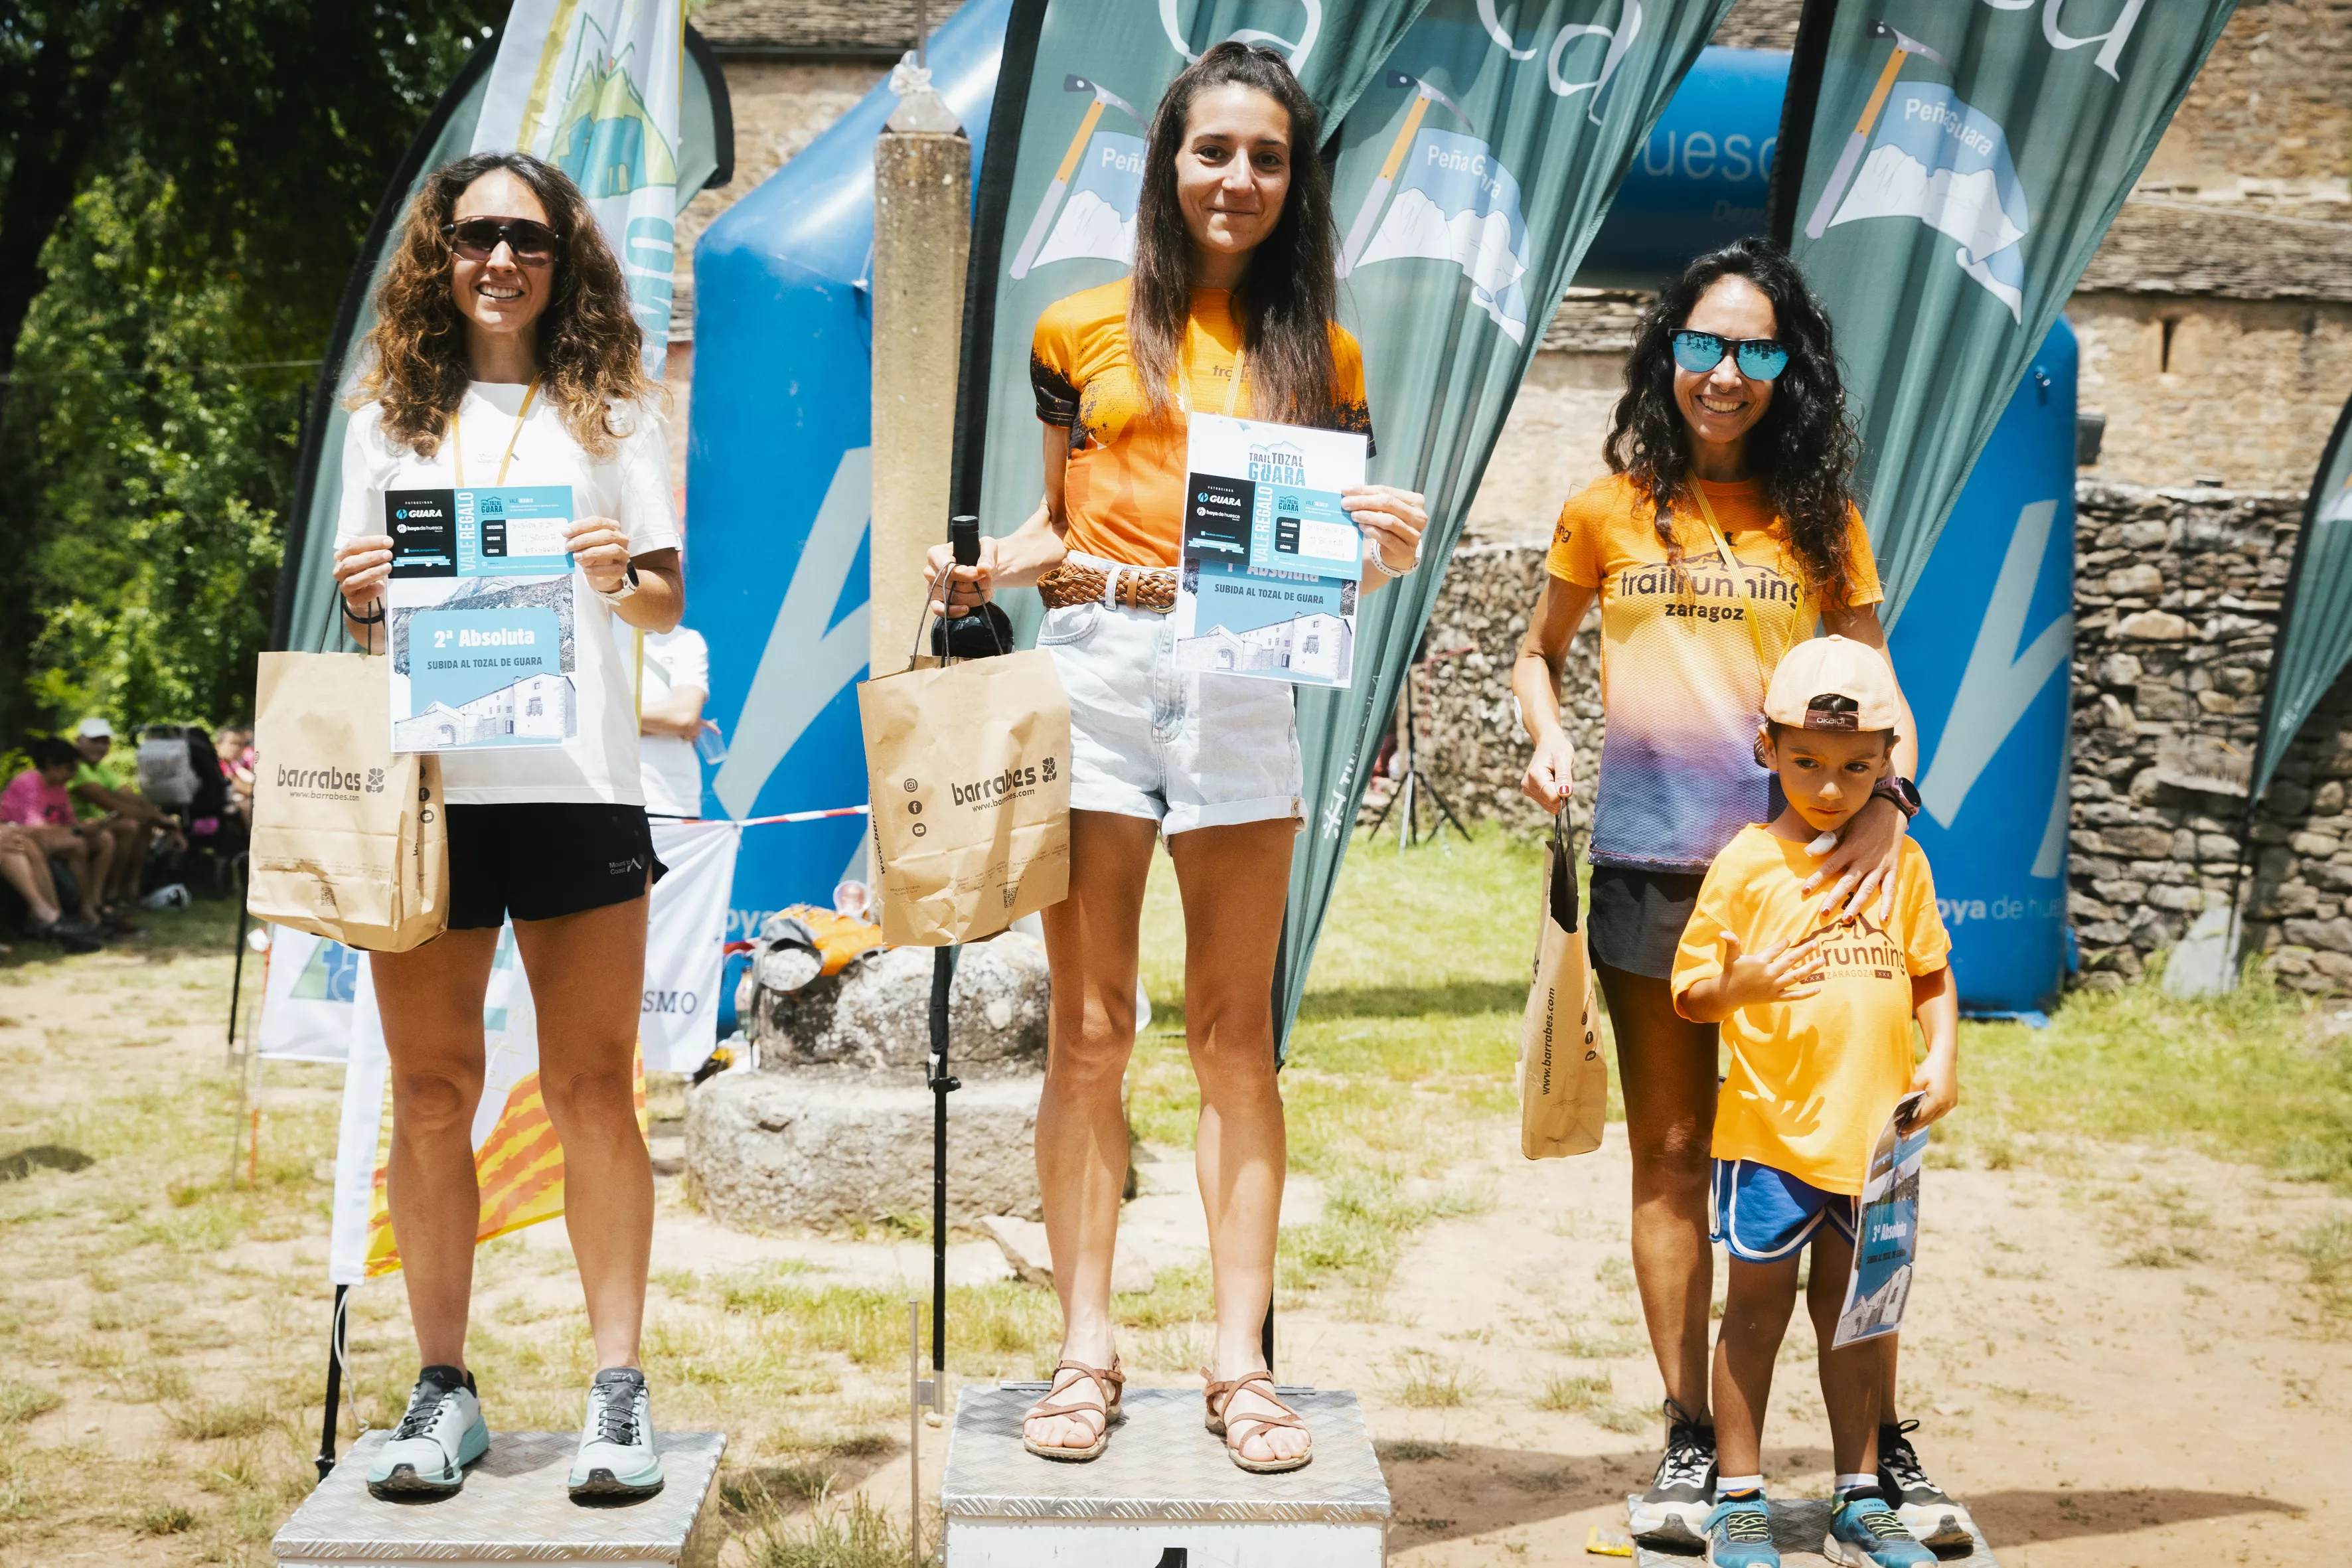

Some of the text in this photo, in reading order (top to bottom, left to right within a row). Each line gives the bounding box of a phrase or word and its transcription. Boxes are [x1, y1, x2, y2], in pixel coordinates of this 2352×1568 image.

[1428, 145, 1469, 172] Peña
[1644, 131, 1778, 183] uesc
[1249, 453, 1304, 467] TRAIL TOZAL
[1249, 463, 1306, 486] GUARA
[1210, 495, 1241, 507] GUARA
[1279, 503, 1298, 512] GUARA
[408, 509, 443, 518] GUARA
[1253, 486, 1273, 562] VALE REGALO
[457, 492, 477, 572] VALE REGALO
[1215, 584, 1324, 604] SUBIDA AL TOZAL DE GUARA
[1665, 603, 1747, 623] zaragoz
[434, 628, 535, 648] 2ª Absoluta
[428, 657, 542, 670] SUBIDA AL TOZAL DE GUARA
[277, 763, 361, 791] barrabes
[951, 766, 1037, 807] barrabes
[289, 790, 360, 802] www.barrabes.com
[1936, 898, 1986, 925] oya
[1992, 896, 2023, 919] de
[1826, 969, 1875, 980] ZARAGOZA
[641, 990, 698, 1014] SMO
[1542, 987, 1556, 1095] www.barrabes.com
